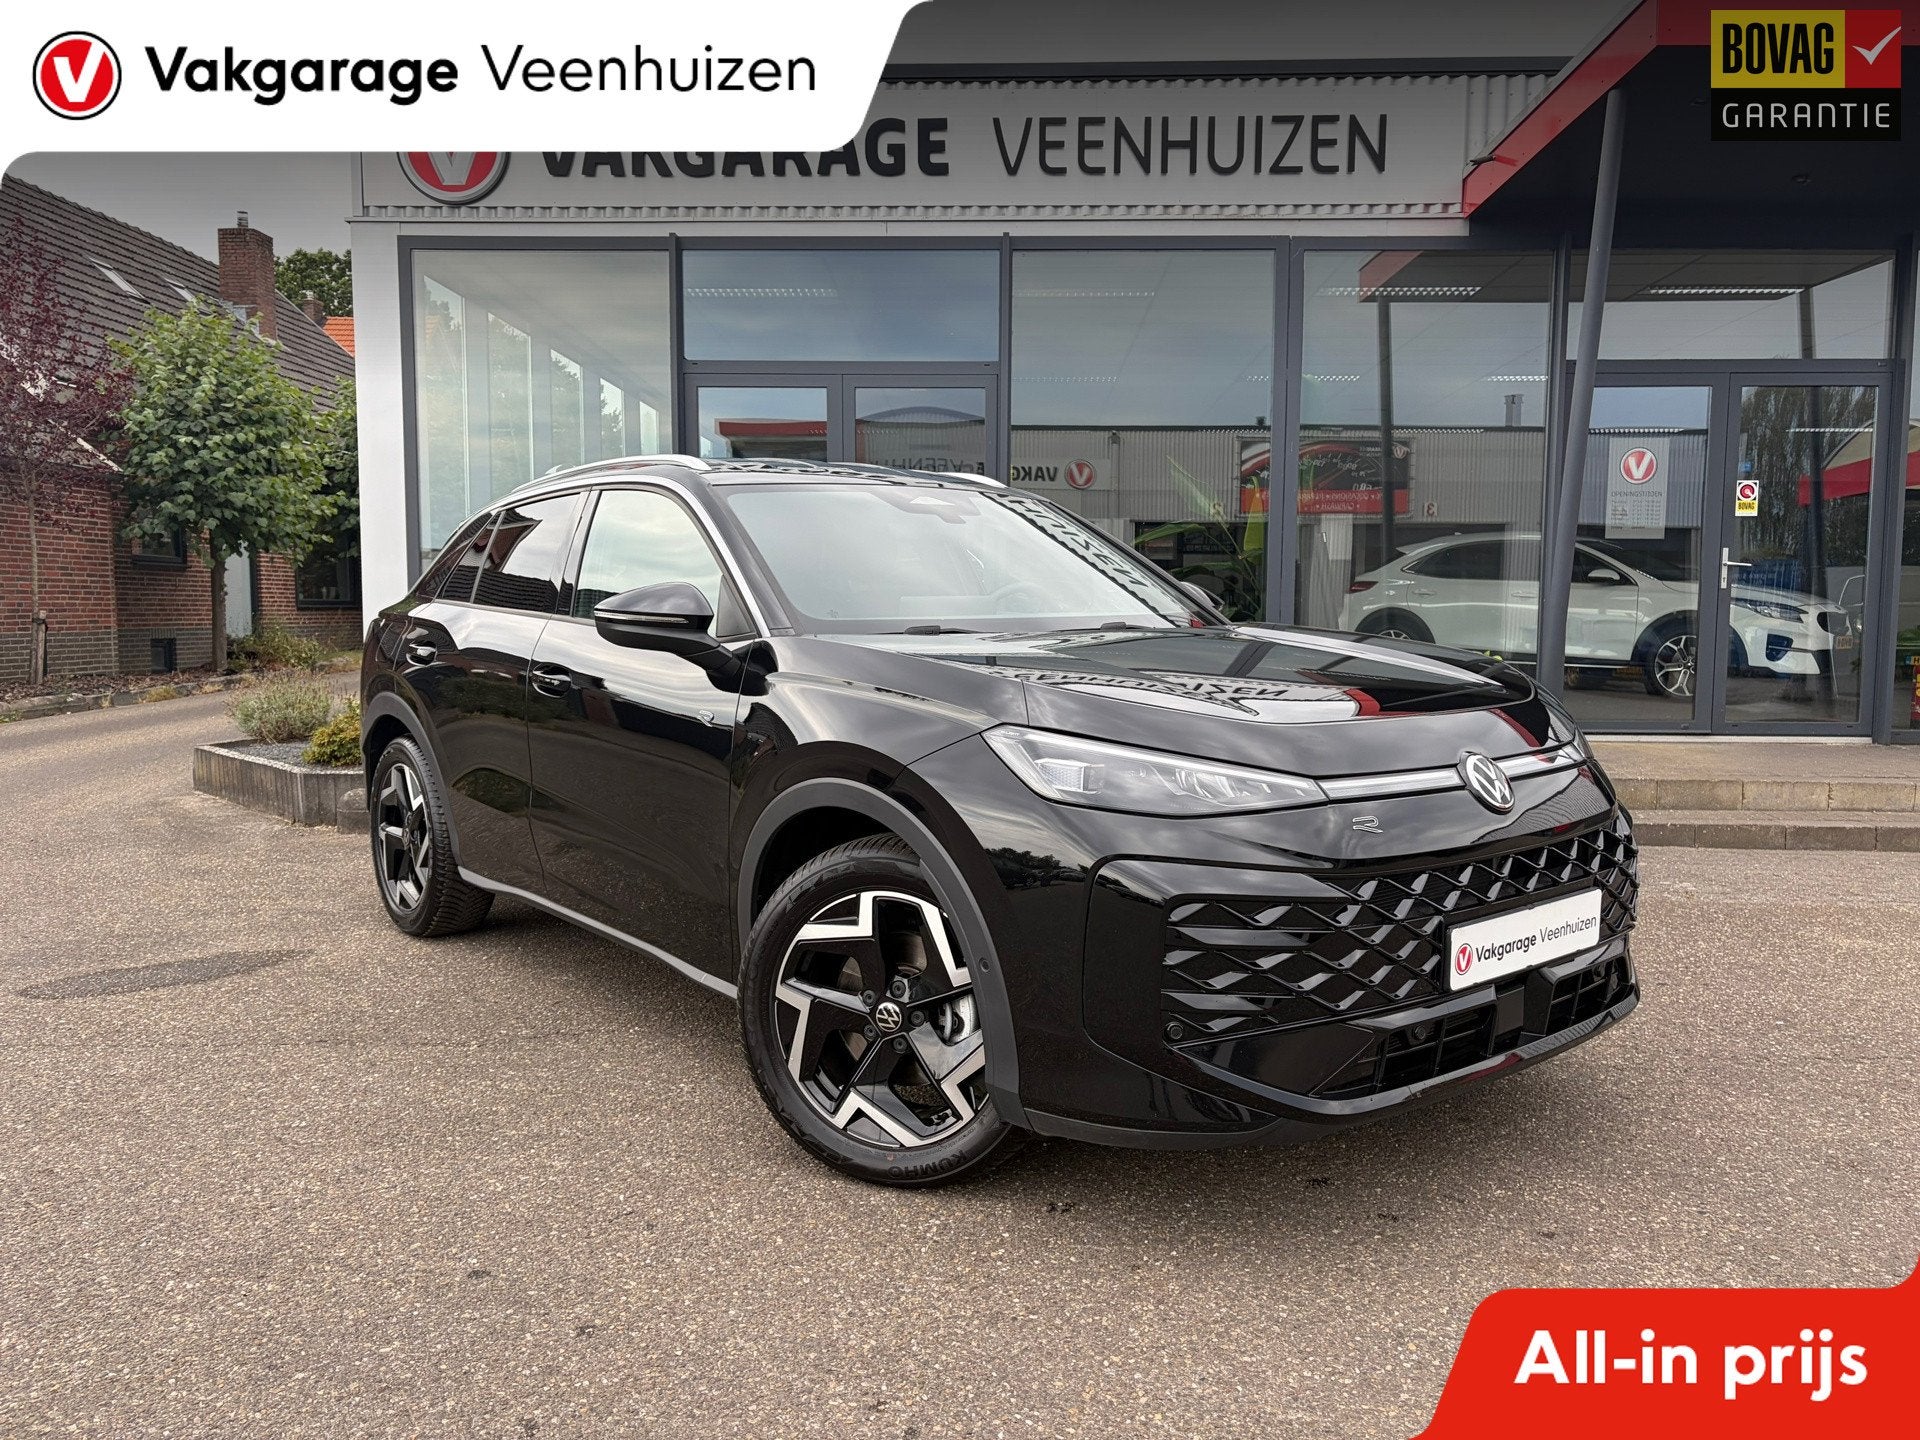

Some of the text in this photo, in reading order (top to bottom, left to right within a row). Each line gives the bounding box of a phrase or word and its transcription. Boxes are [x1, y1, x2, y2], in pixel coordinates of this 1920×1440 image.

[992, 114, 1388, 176] VEENHUIZEN
[1475, 934, 1537, 963] Vakgarage
[1539, 915, 1597, 943] Veenhuizen
